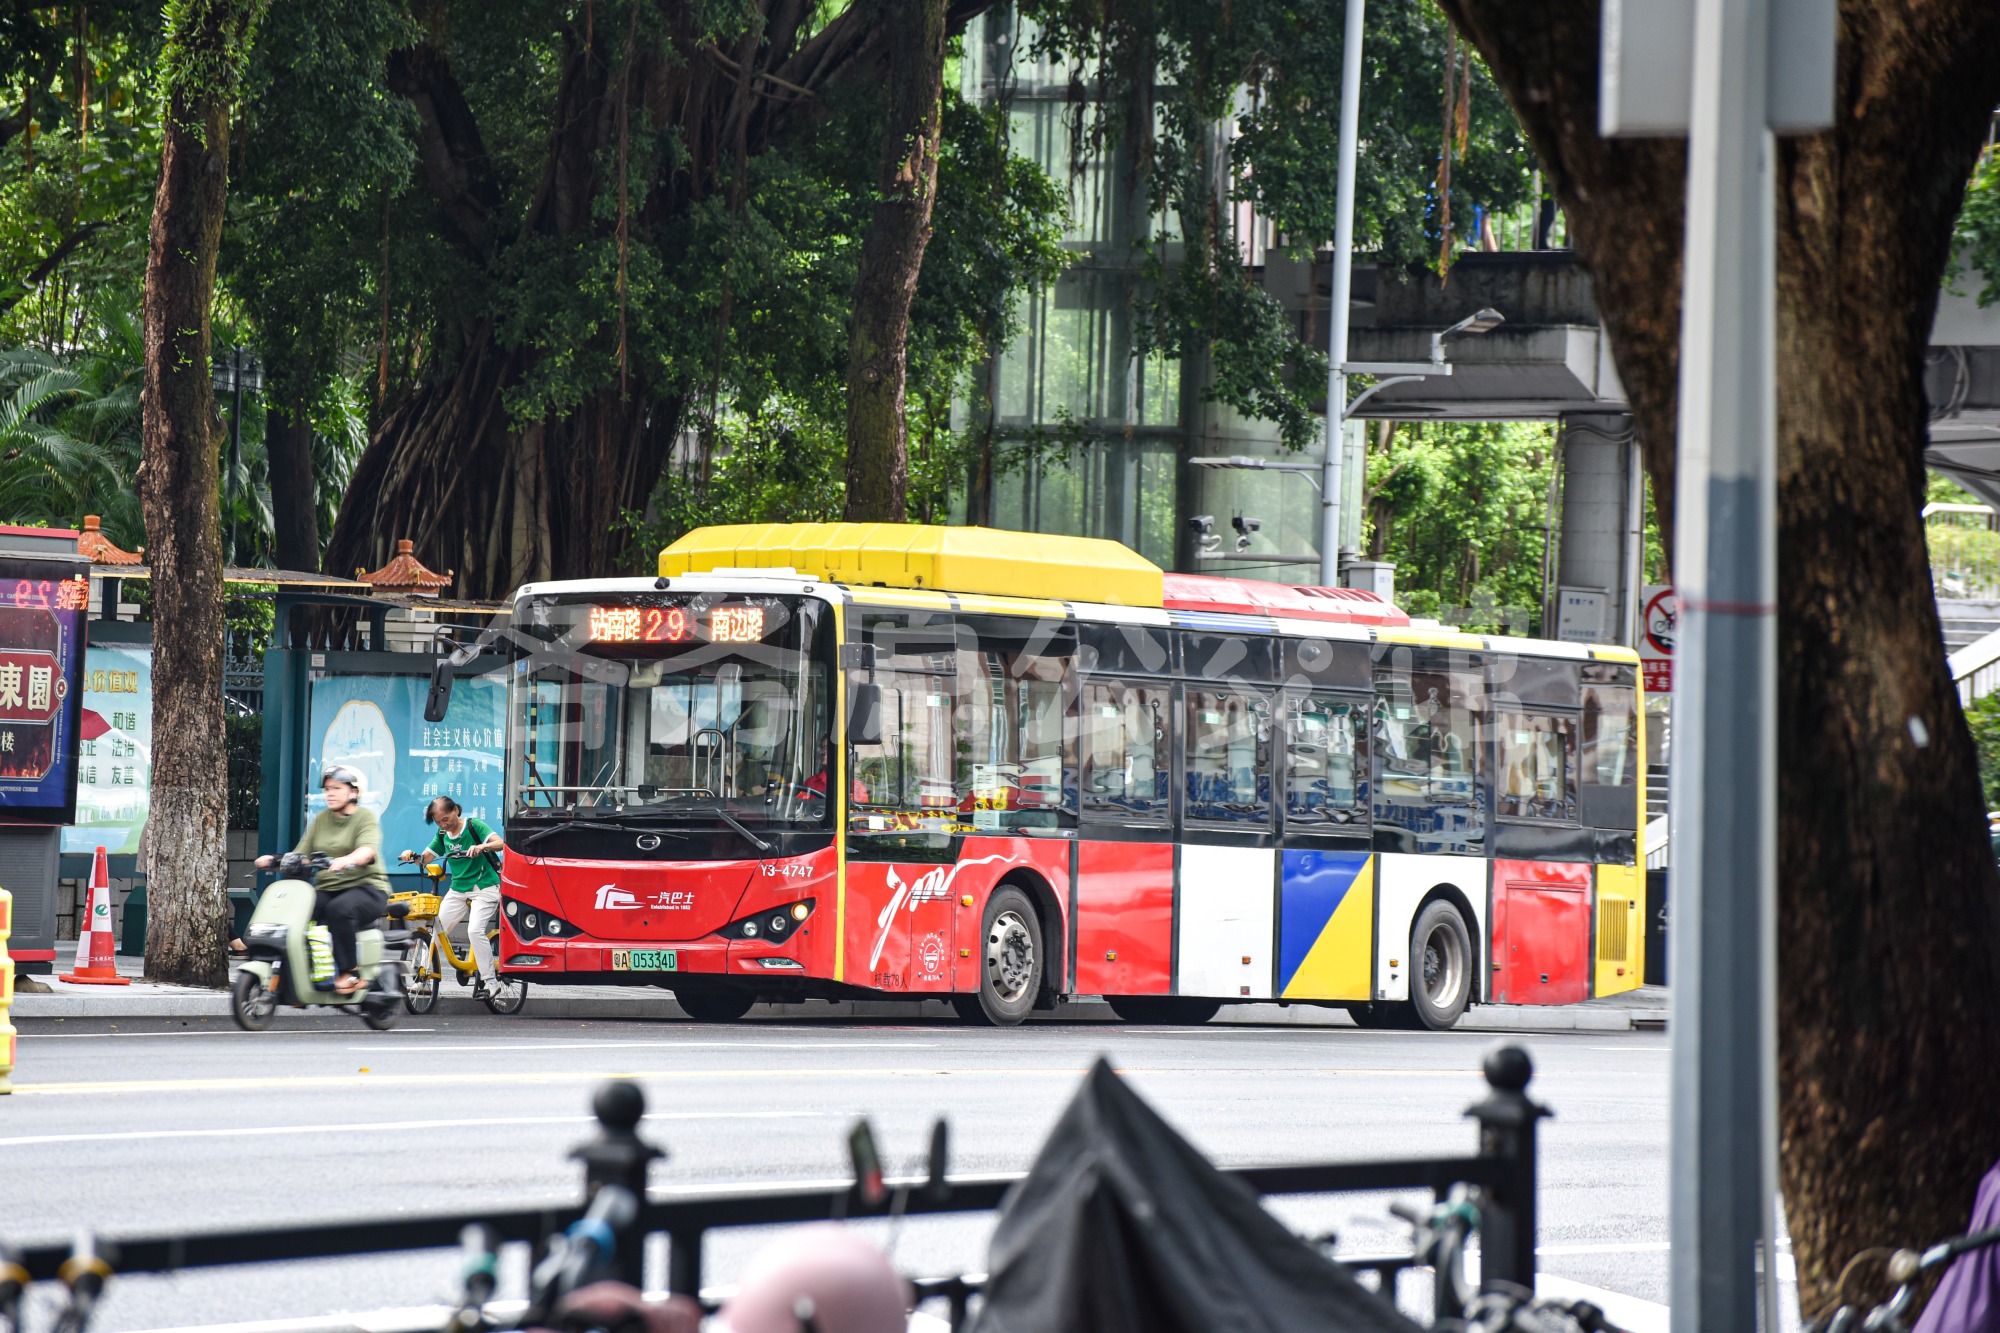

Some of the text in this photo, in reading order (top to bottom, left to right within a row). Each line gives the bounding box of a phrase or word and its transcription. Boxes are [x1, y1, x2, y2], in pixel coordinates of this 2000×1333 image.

[590, 607, 763, 642] 站南路 29 南边路
[112, 712, 136, 731] 和谐
[423, 727, 503, 748] 社会主义核心价值
[112, 738, 135, 757] 法治
[423, 758, 439, 773] 富强
[448, 758, 463, 773] 民主
[474, 759, 488, 773] 文明
[112, 766, 134, 784] 友善
[423, 783, 438, 796] 自由
[448, 783, 462, 796] 平等
[473, 783, 487, 796] 公正
[760, 864, 814, 878] Y3-4747
[646, 891, 695, 905] 一汽巴士
[874, 972, 908, 989] 核载78人
